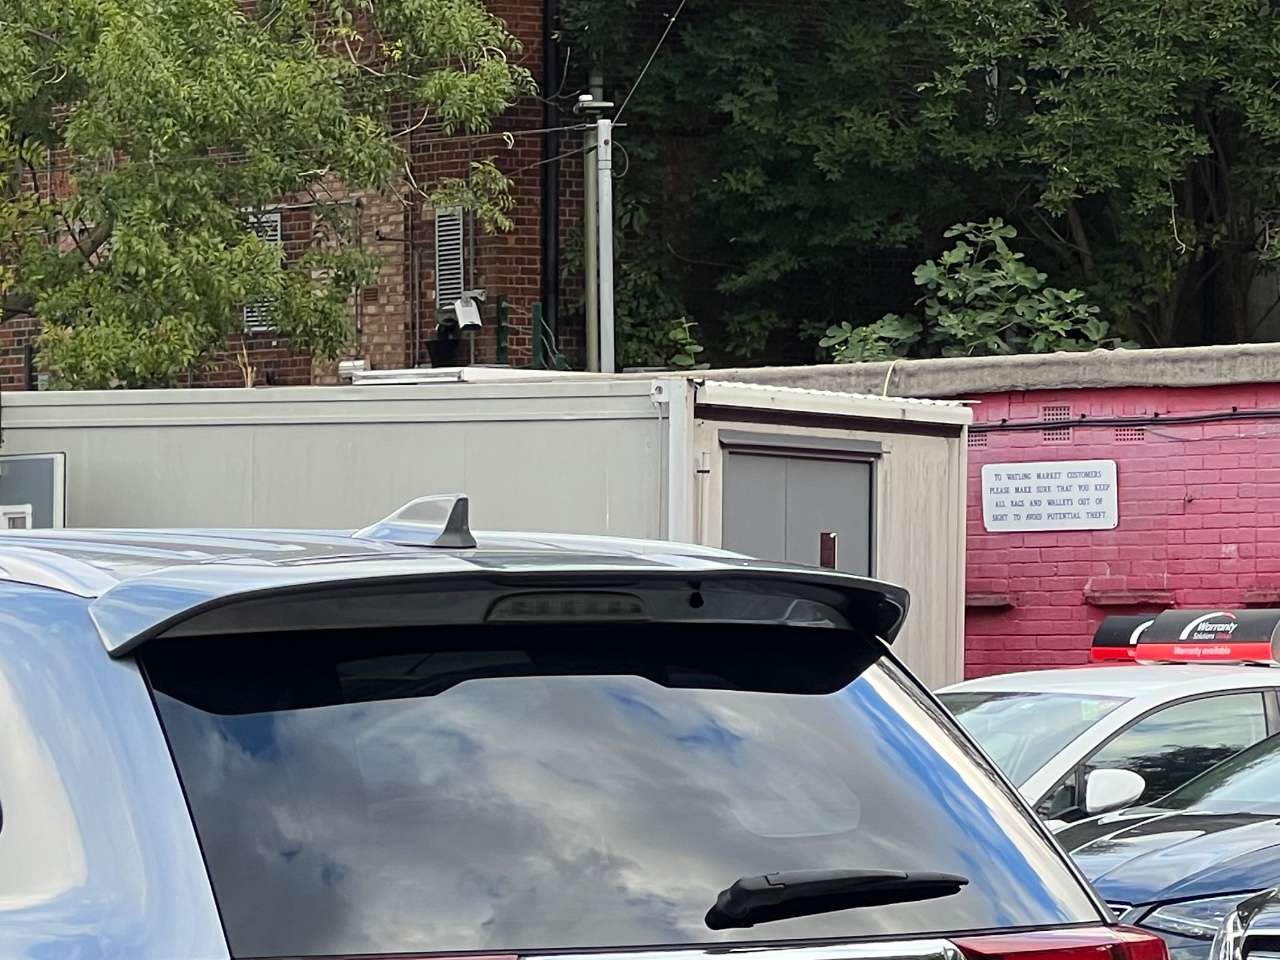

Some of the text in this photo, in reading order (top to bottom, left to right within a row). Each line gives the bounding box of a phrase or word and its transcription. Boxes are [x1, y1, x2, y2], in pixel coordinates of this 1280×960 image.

[994, 473, 1002, 481] TO
[1036, 472, 1062, 480] MARKET
[1066, 471, 1102, 479] CUSTOMERS
[989, 484, 1110, 495] PLEASE MAKE SURE THAT YOU KEEP
[995, 500, 1006, 508] ALL
[1047, 499, 1074, 507] WALLETS
[1078, 498, 1090, 506] OUT
[1013, 513, 1021, 521] TO
[1047, 512, 1081, 520] POTENTIAL
[1196, 621, 1239, 635] Warranty
